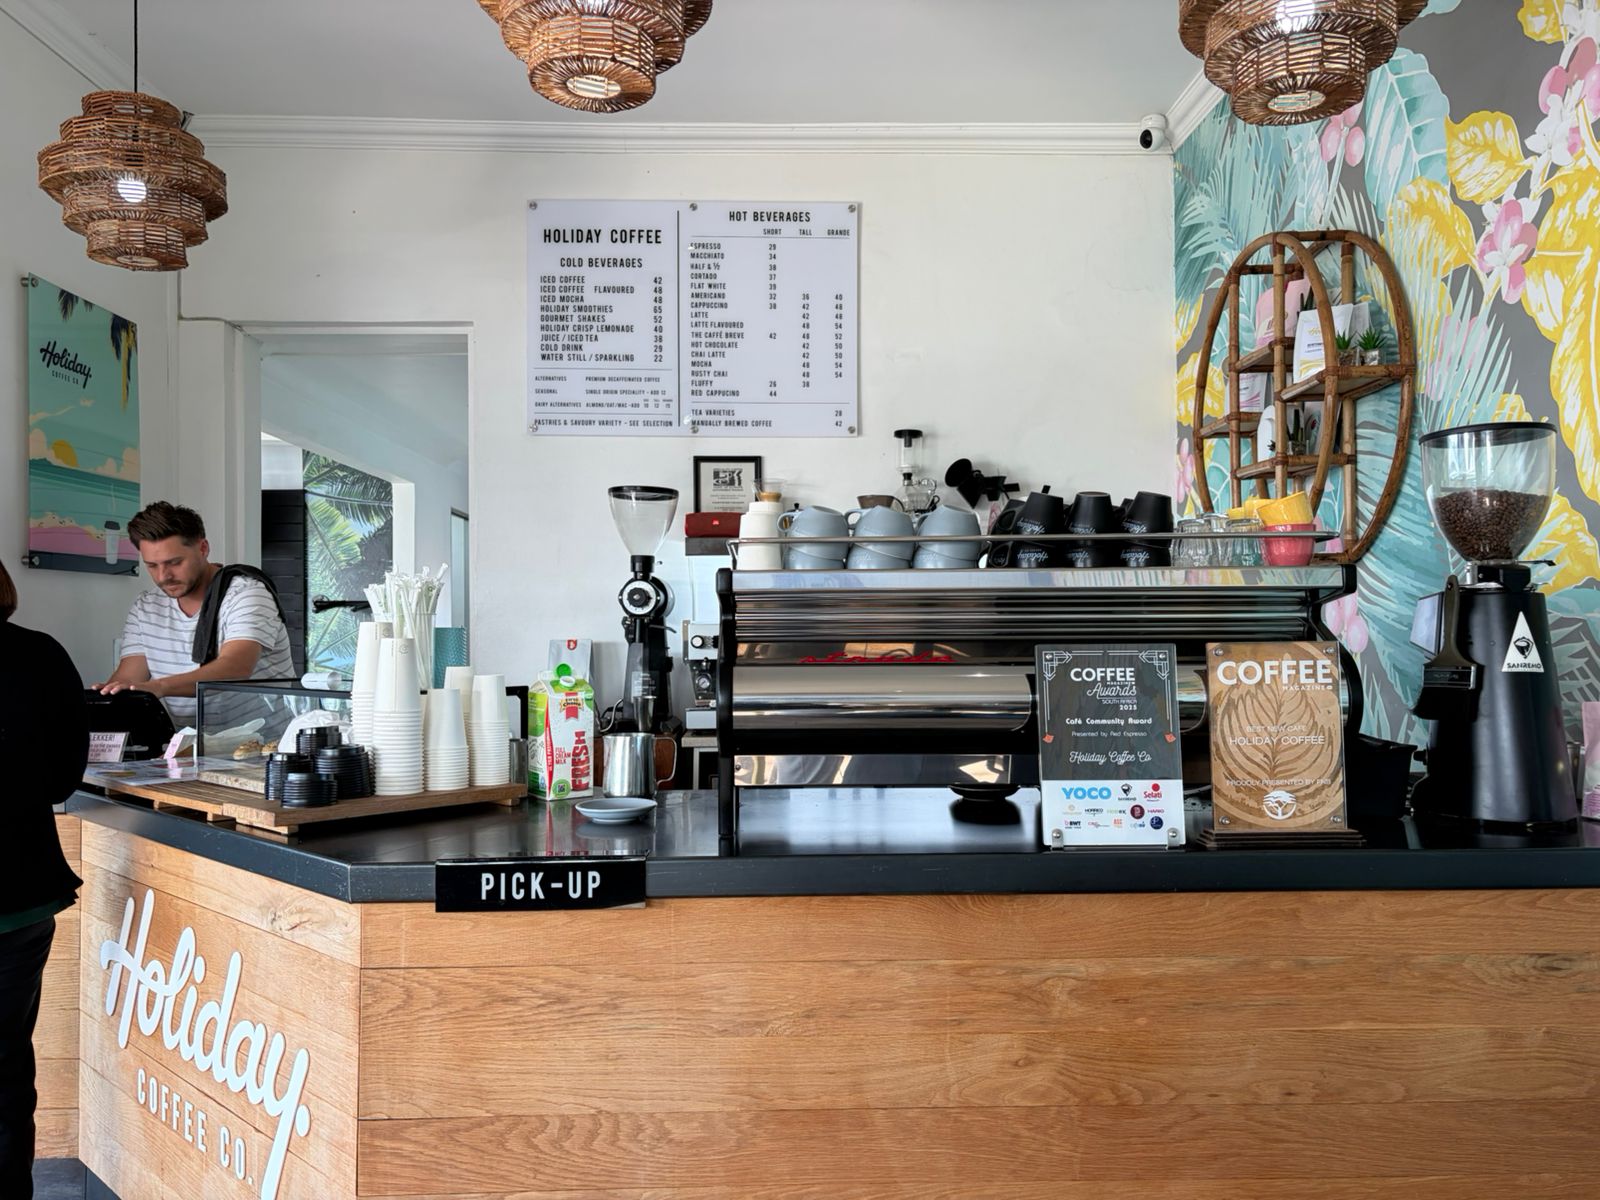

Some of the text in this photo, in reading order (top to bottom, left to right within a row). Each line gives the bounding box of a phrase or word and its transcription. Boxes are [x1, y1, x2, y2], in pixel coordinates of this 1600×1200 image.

[729, 211, 810, 222] HOT BEVERAGES
[543, 229, 662, 244] HOLIDAY COFFEE
[560, 258, 643, 268] COLD BEVERAGES
[594, 286, 634, 294] FLAVOURED
[654, 296, 662, 304] 48
[540, 305, 569, 313] HOLIDAY
[572, 305, 613, 313] SMOOTHIES
[578, 315, 606, 323] SHAKES
[596, 325, 634, 333] LEMONADE
[541, 334, 560, 342] JUICE
[595, 354, 634, 362] SPARKLING
[1016, 551, 1048, 562] Holiday
[1070, 668, 1135, 681] COFFEE
[1217, 660, 1333, 685] COFFEE
[1086, 683, 1137, 699] Awards
[1066, 717, 1152, 726] Café Community Award
[1229, 736, 1325, 746] HOLIDAY COFFEE
[571, 730, 590, 791] FRESH
[1069, 751, 1152, 765] Holiday Coffee Co
[1062, 787, 1111, 800] YOCO
[1143, 791, 1162, 799] Selati
[480, 871, 602, 901] PICK-UP
[100, 888, 311, 1200] Holiday.
[136, 1068, 254, 1185] COFFEE CO.
